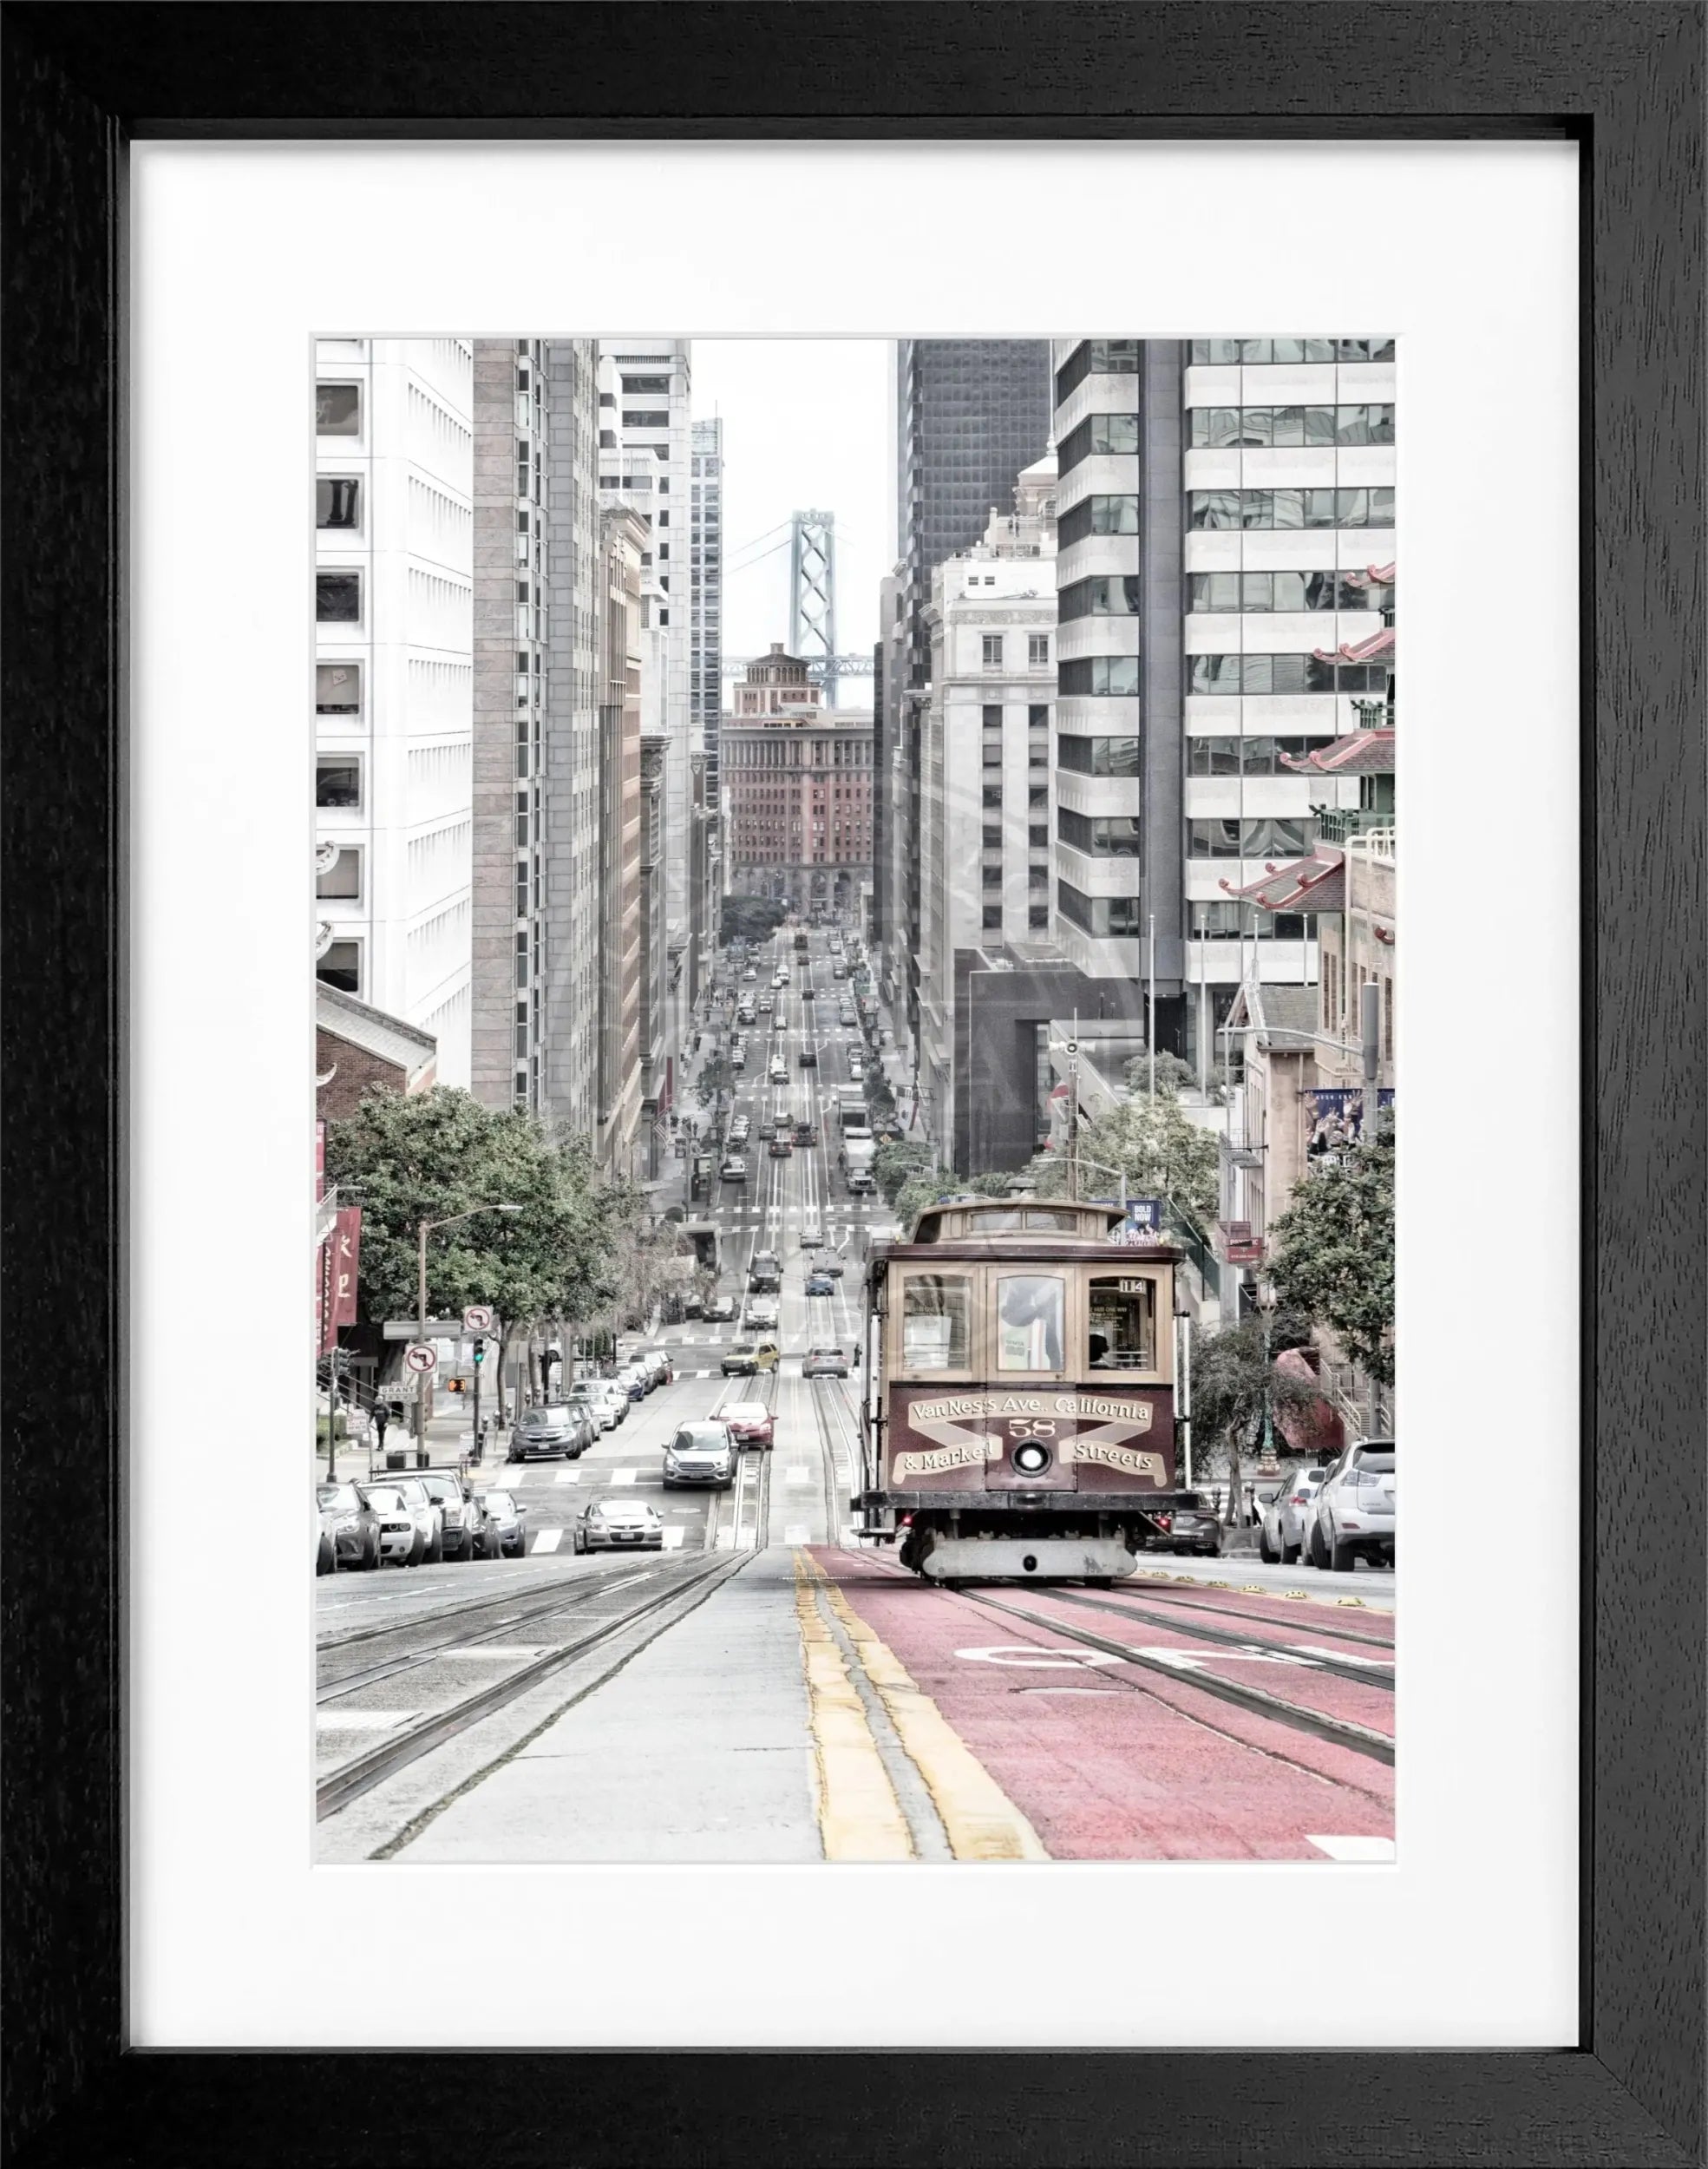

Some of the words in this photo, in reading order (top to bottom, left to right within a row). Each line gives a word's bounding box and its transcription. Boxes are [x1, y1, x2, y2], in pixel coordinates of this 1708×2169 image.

[913, 1403, 945, 1420] Van
[1055, 1397, 1149, 1420] California
[1009, 1419, 1056, 1438] 58
[904, 1453, 918, 1471] &
[921, 1438, 993, 1470] Market
[1074, 1443, 1153, 1470] Streets
